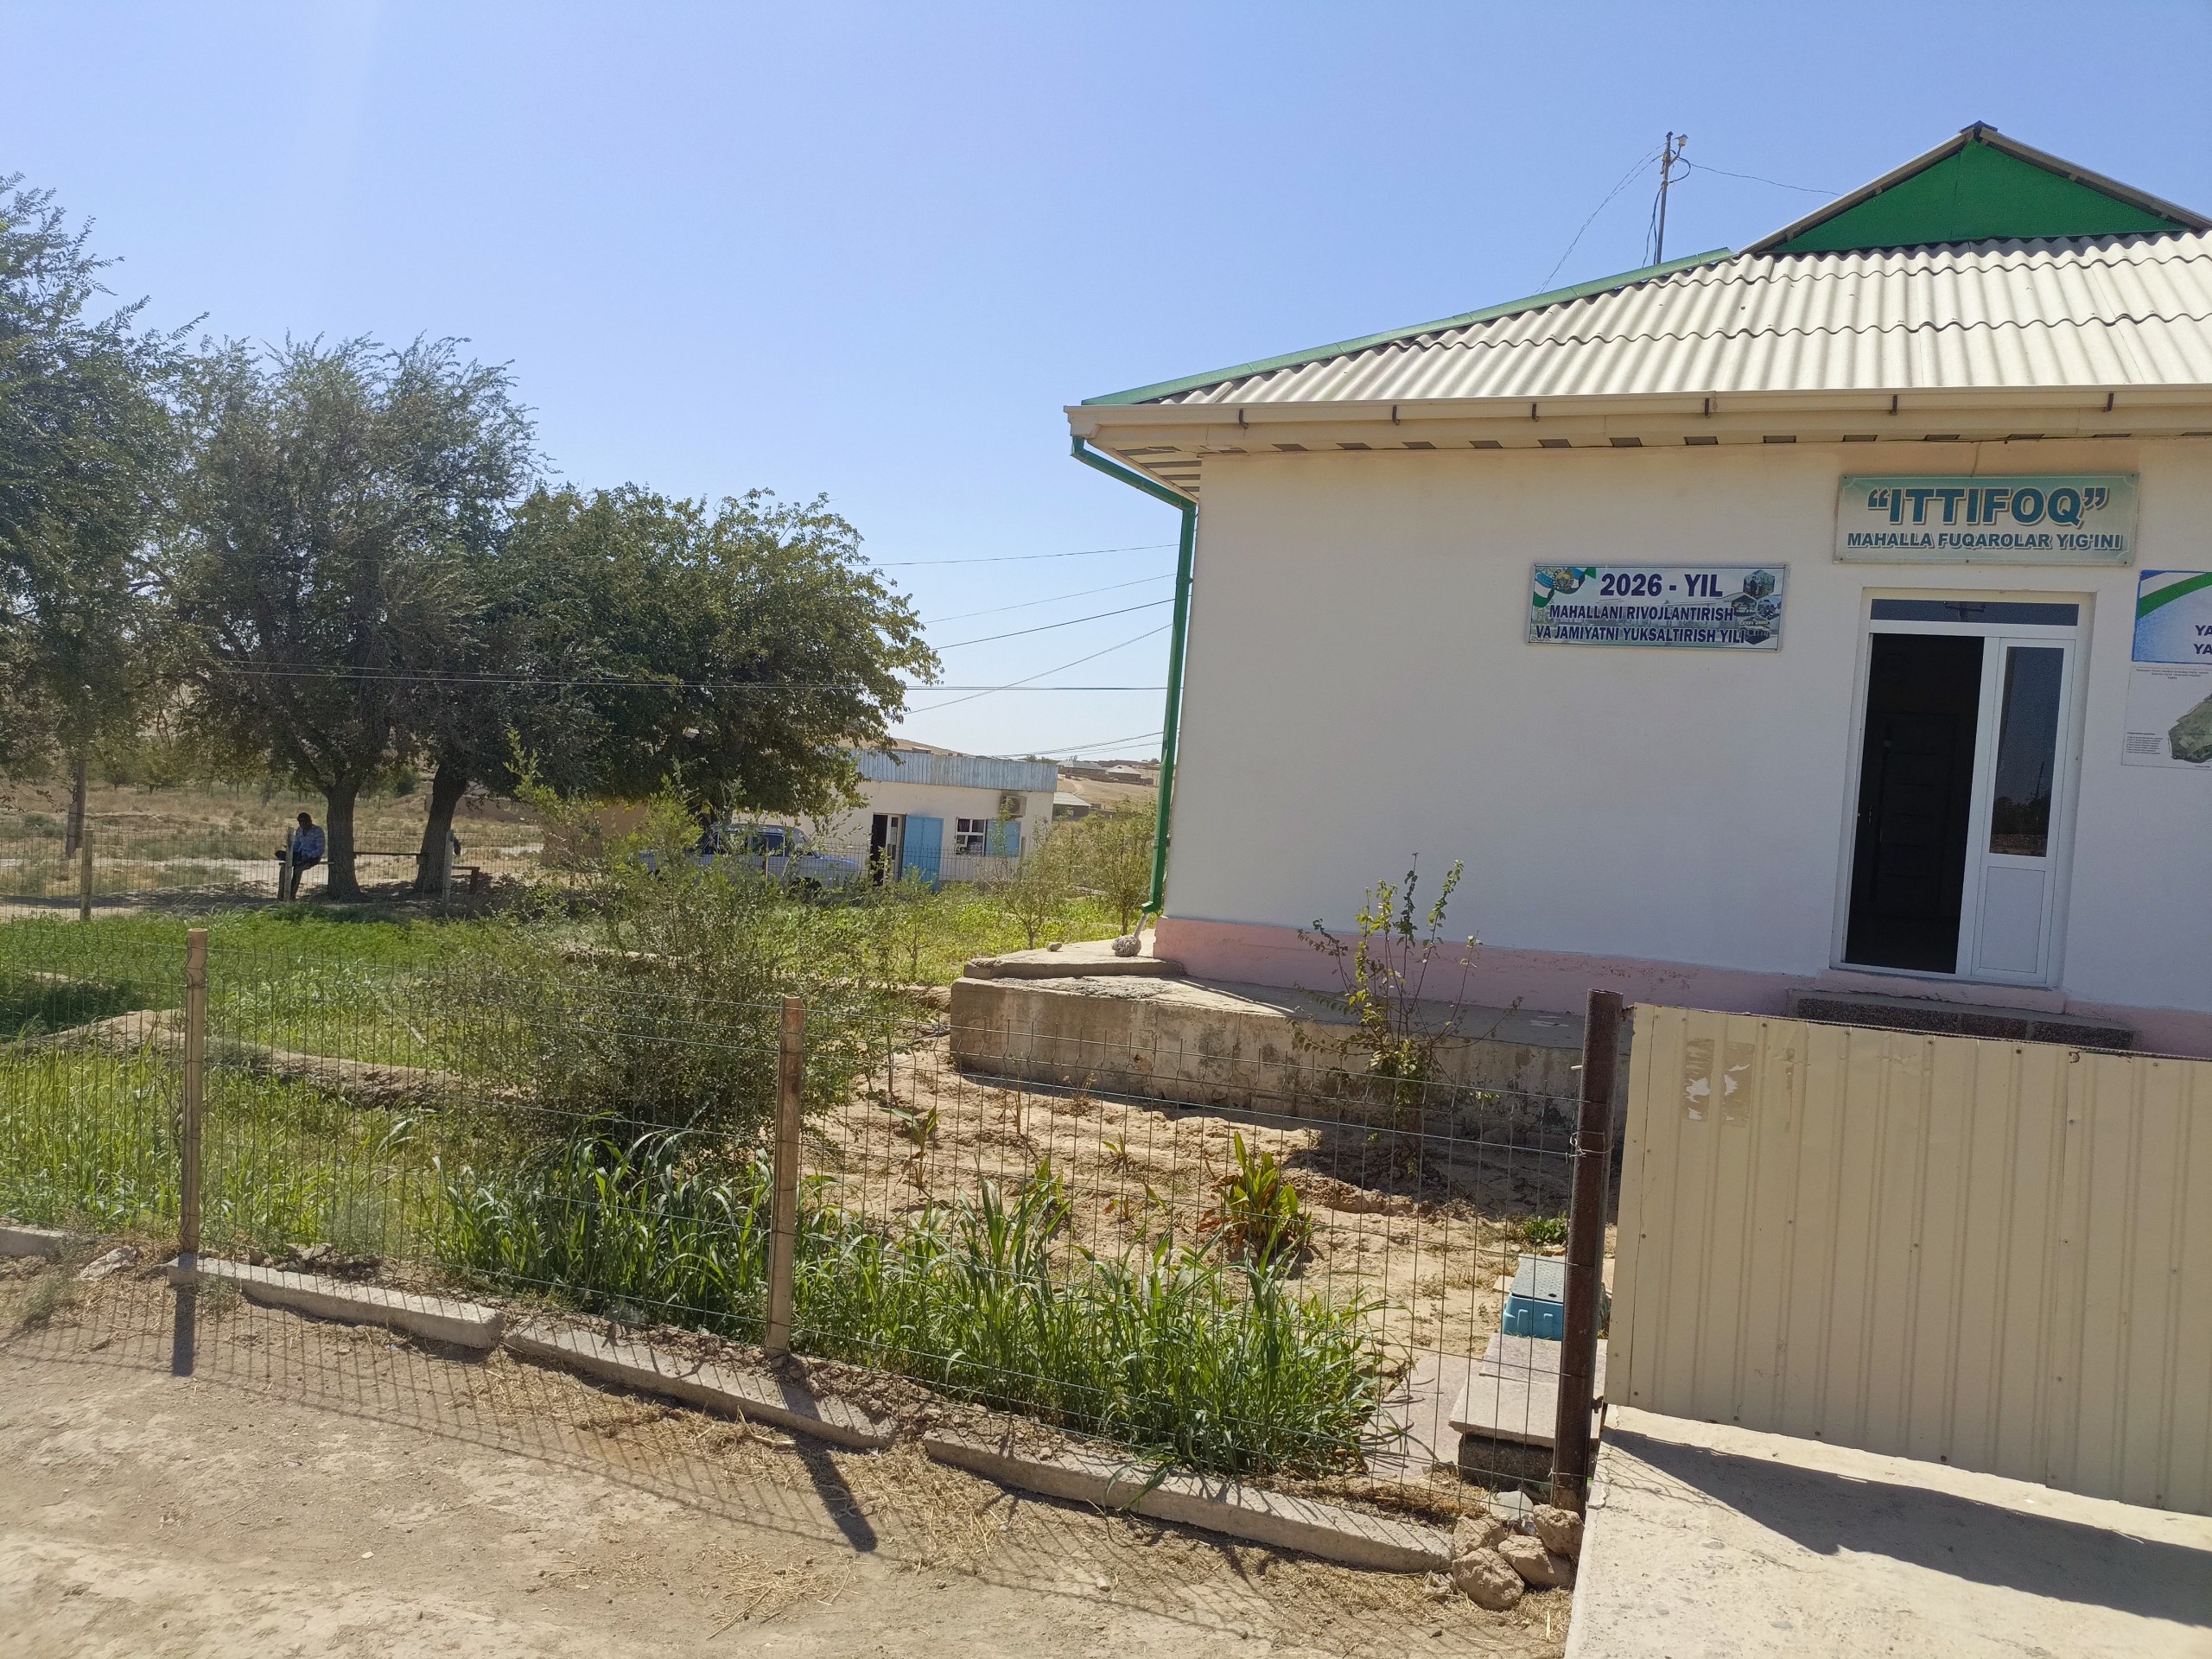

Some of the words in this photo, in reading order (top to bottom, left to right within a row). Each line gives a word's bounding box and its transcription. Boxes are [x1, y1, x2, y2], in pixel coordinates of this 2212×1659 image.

[1847, 532, 1933, 548] MAHALLA
[1938, 533, 2051, 549] FUQAROLAR
[1600, 573, 1662, 596] 2026
[1684, 574, 1723, 597] YIL
[1549, 605, 1623, 620] MAHALLANI
[1627, 606, 1733, 620] RIVOJLANTIRISH
[1535, 625, 1551, 639] VA
[1554, 626, 1619, 640] JAMIYATNI
[1623, 628, 1716, 642] YUKSALTIRISH
[1720, 630, 1745, 643] YILI
